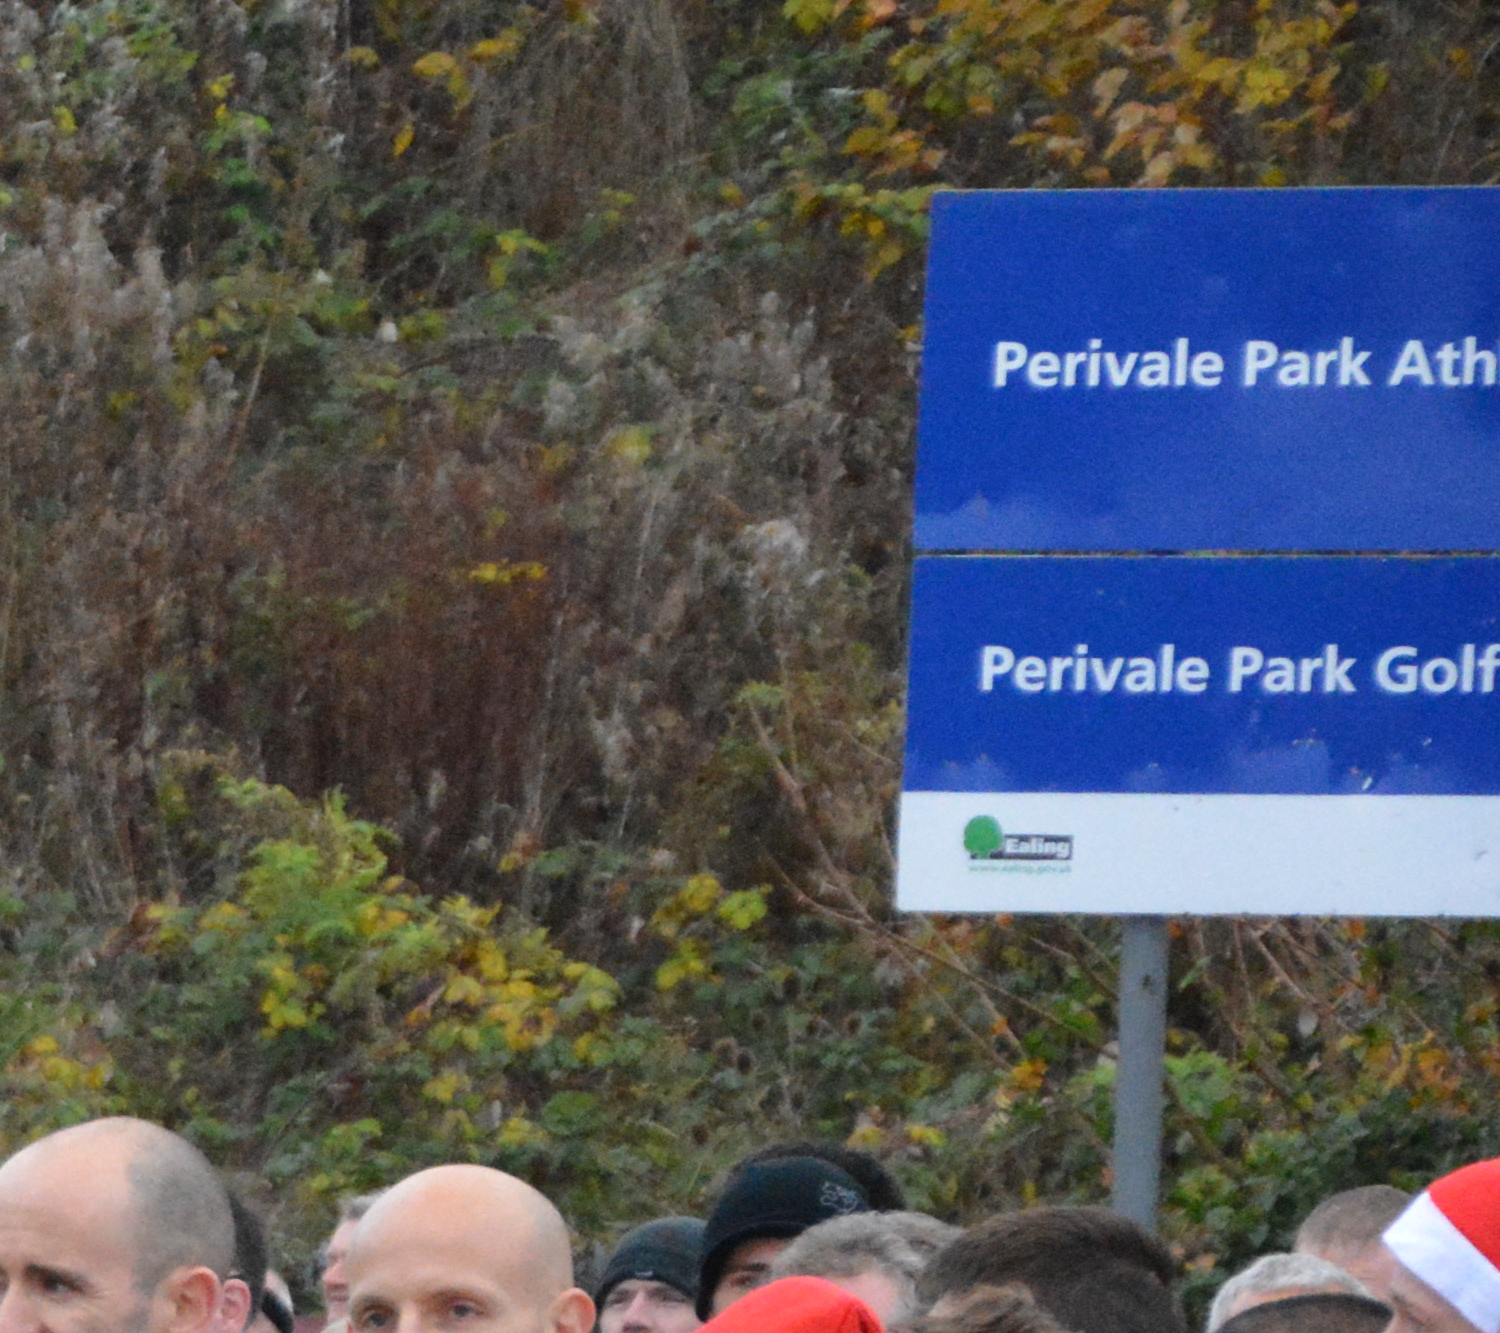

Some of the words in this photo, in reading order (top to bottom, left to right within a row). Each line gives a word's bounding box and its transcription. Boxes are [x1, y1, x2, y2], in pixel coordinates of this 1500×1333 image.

[993, 337, 1225, 388] Perivale
[1243, 336, 1371, 386] Park
[978, 643, 1211, 694] Perivale
[1227, 643, 1357, 693] Park
[1374, 643, 1500, 693] Golf
[1005, 837, 1071, 859] Ealing
